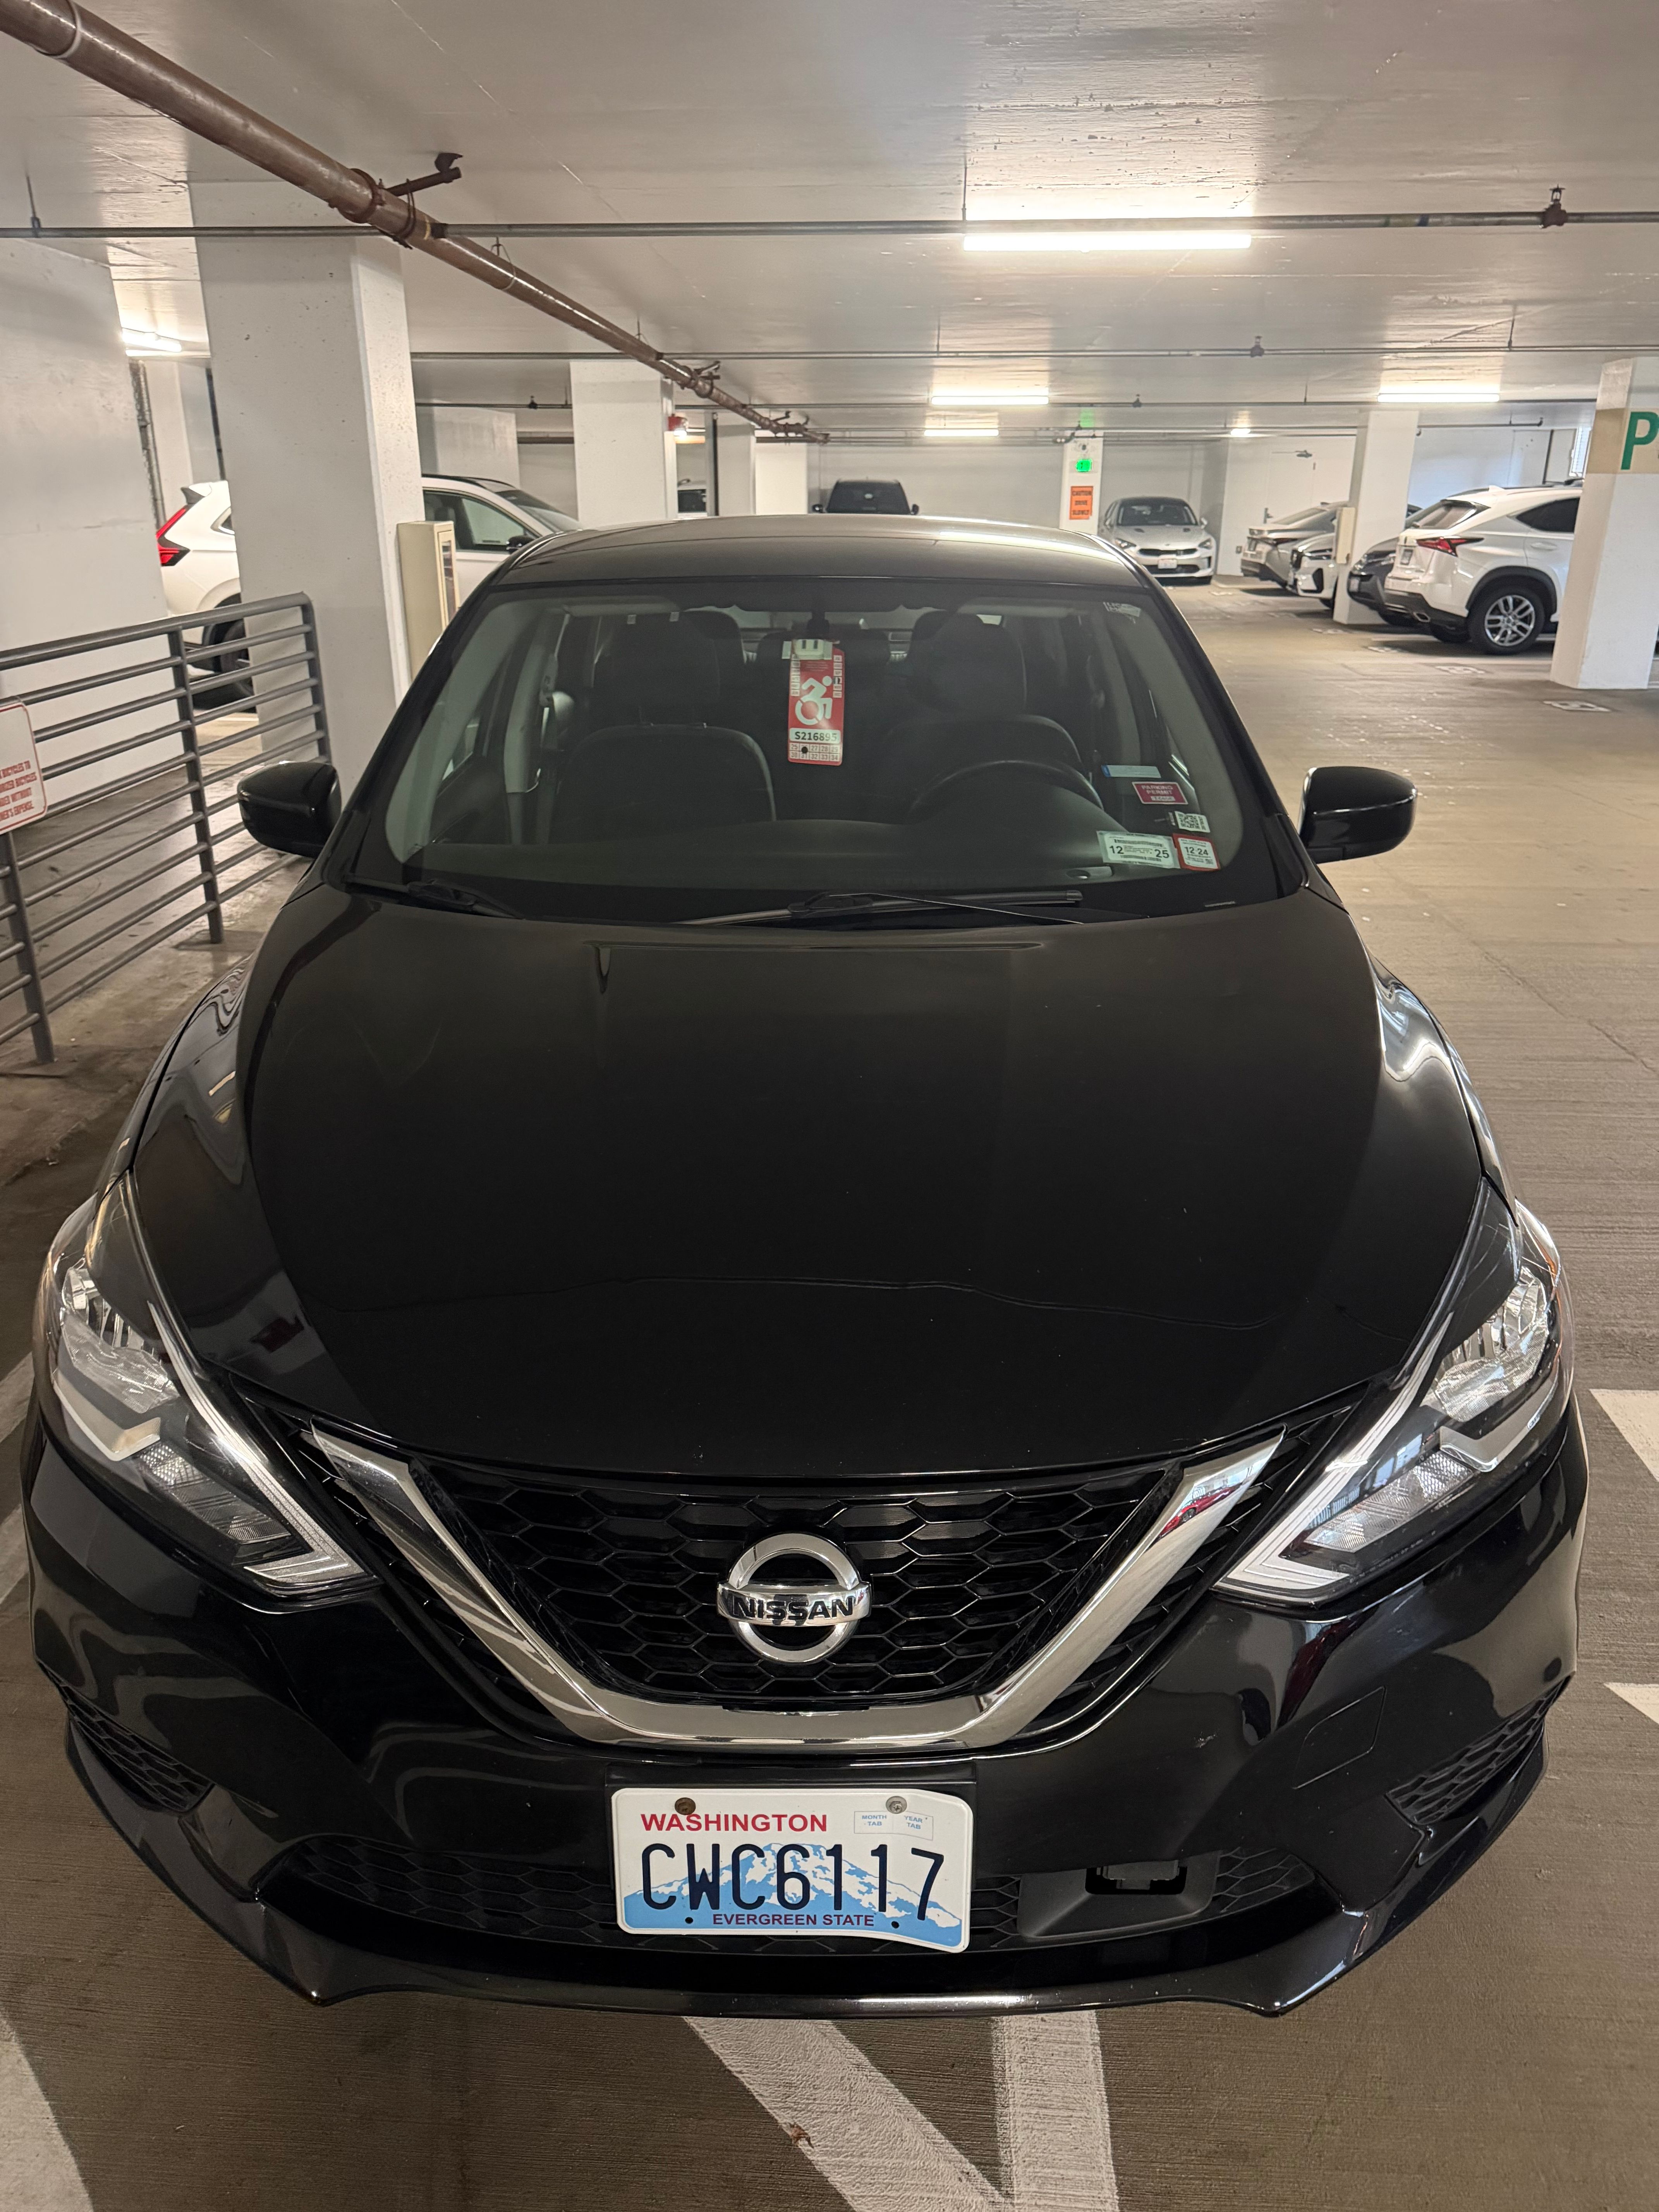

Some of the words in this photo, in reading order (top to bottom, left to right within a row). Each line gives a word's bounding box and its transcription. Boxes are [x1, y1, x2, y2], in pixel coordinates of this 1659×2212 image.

[795, 731, 837, 741] S216895
[1109, 845, 1124, 854] 12
[1154, 849, 1170, 859] 25
[732, 1596, 855, 1620] NISSAN
[641, 1814, 827, 1832] WASHINGTON
[642, 1844, 944, 1921] CWC6117
[713, 1914, 819, 1926] EVERGREEN
[823, 1915, 874, 1926] STATE
